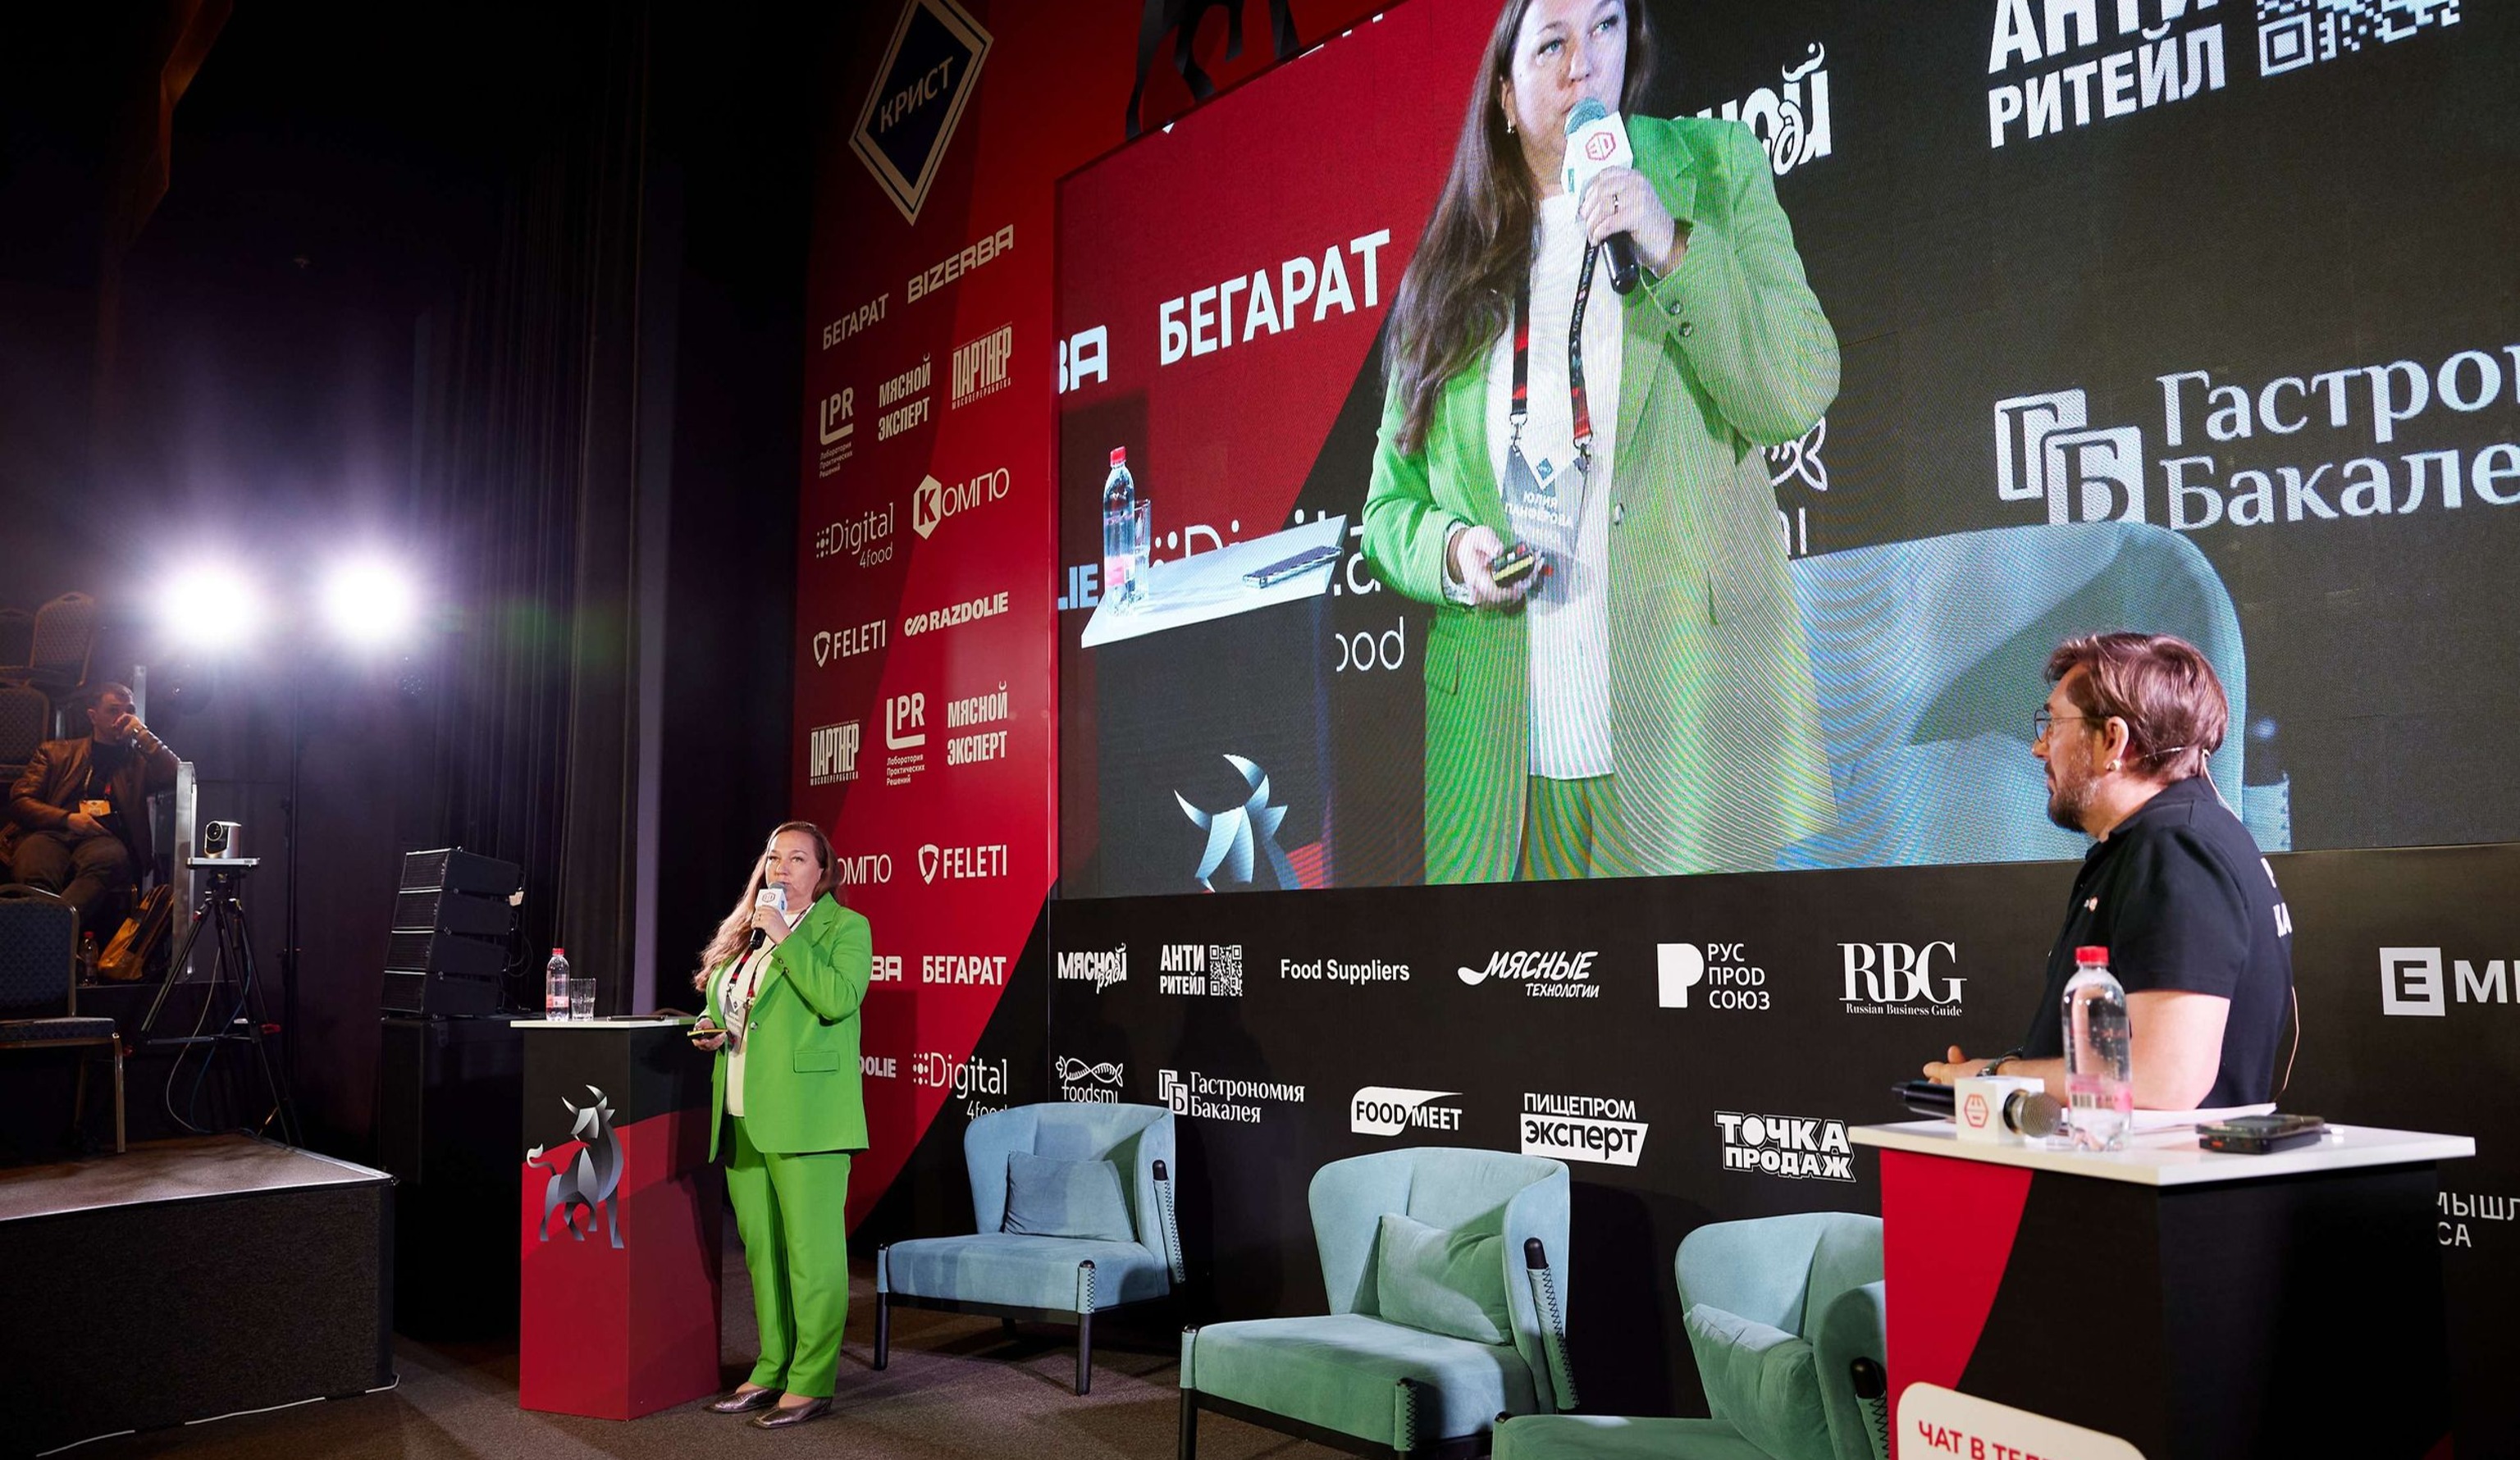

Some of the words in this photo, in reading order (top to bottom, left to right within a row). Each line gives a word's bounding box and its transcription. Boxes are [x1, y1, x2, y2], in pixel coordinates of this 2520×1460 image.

[879, 56, 953, 134] КРИСТ
[1988, 21, 2226, 148] РИТЕЙЛ
[907, 224, 1014, 304] BIZERBA
[1159, 228, 1390, 366] БЕГАРАТ
[823, 293, 888, 350] БЕГАРАТ
[879, 352, 931, 408] МЯСНОЙ
[952, 326, 1012, 401] ПАРТНЕР
[2156, 343, 2520, 447] Гастро
[820, 387, 854, 445] LPR
[879, 397, 930, 441] ЭКСПЕРТ
[829, 501, 894, 555] Digital
[860, 541, 893, 568] 4food
[929, 591, 1008, 632] RAZDOLIE
[833, 619, 886, 660] FELETI
[886, 692, 925, 751] LPR
[947, 680, 1008, 729] МЯСНОЙ
[810, 723, 860, 778] ПАРТНЕР
[947, 730, 1008, 766] ЭКСПЕРТ
[943, 844, 1007, 879] FELETI
[922, 956, 1007, 985] БЕГАРАТ
[1057, 942, 1127, 981] МЯСНОЙ
[1160, 944, 1205, 972] АНТИ
[1281, 959, 1322, 979] Food
[1326, 958, 1410, 986] Suppliers
[1458, 951, 1599, 986] МЯСНЫЕ
[1707, 943, 1745, 962] РУС
[1160, 971, 1206, 996] РИТЕЙЛ
[1525, 983, 1600, 998] ТЕХНОЛОГИИ
[1837, 941, 1968, 1005] RBG
[1709, 989, 1771, 1011] СОЮЗ
[1846, 1002, 1884, 1015] Russian
[1886, 1003, 1929, 1016] Business
[1931, 1005, 1963, 1016] Guide
[929, 1052, 1007, 1100] Digital
[1061, 1078, 1118, 1104] foodsmi
[1190, 1071, 1305, 1103] Гастрономия
[1190, 1096, 1262, 1124] Бакалея
[1356, 1100, 1407, 1125] FOOD
[1411, 1106, 1463, 1131] MEET
[1523, 1092, 1637, 1120] ПИЩЕПРОМ
[1716, 1113, 1851, 1155] ТОЧКА
[1724, 1146, 1852, 1179] ПРОДАЖ
[1918, 1420, 1963, 1454] ЧАТ
[1970, 1436, 1985, 1460] В
